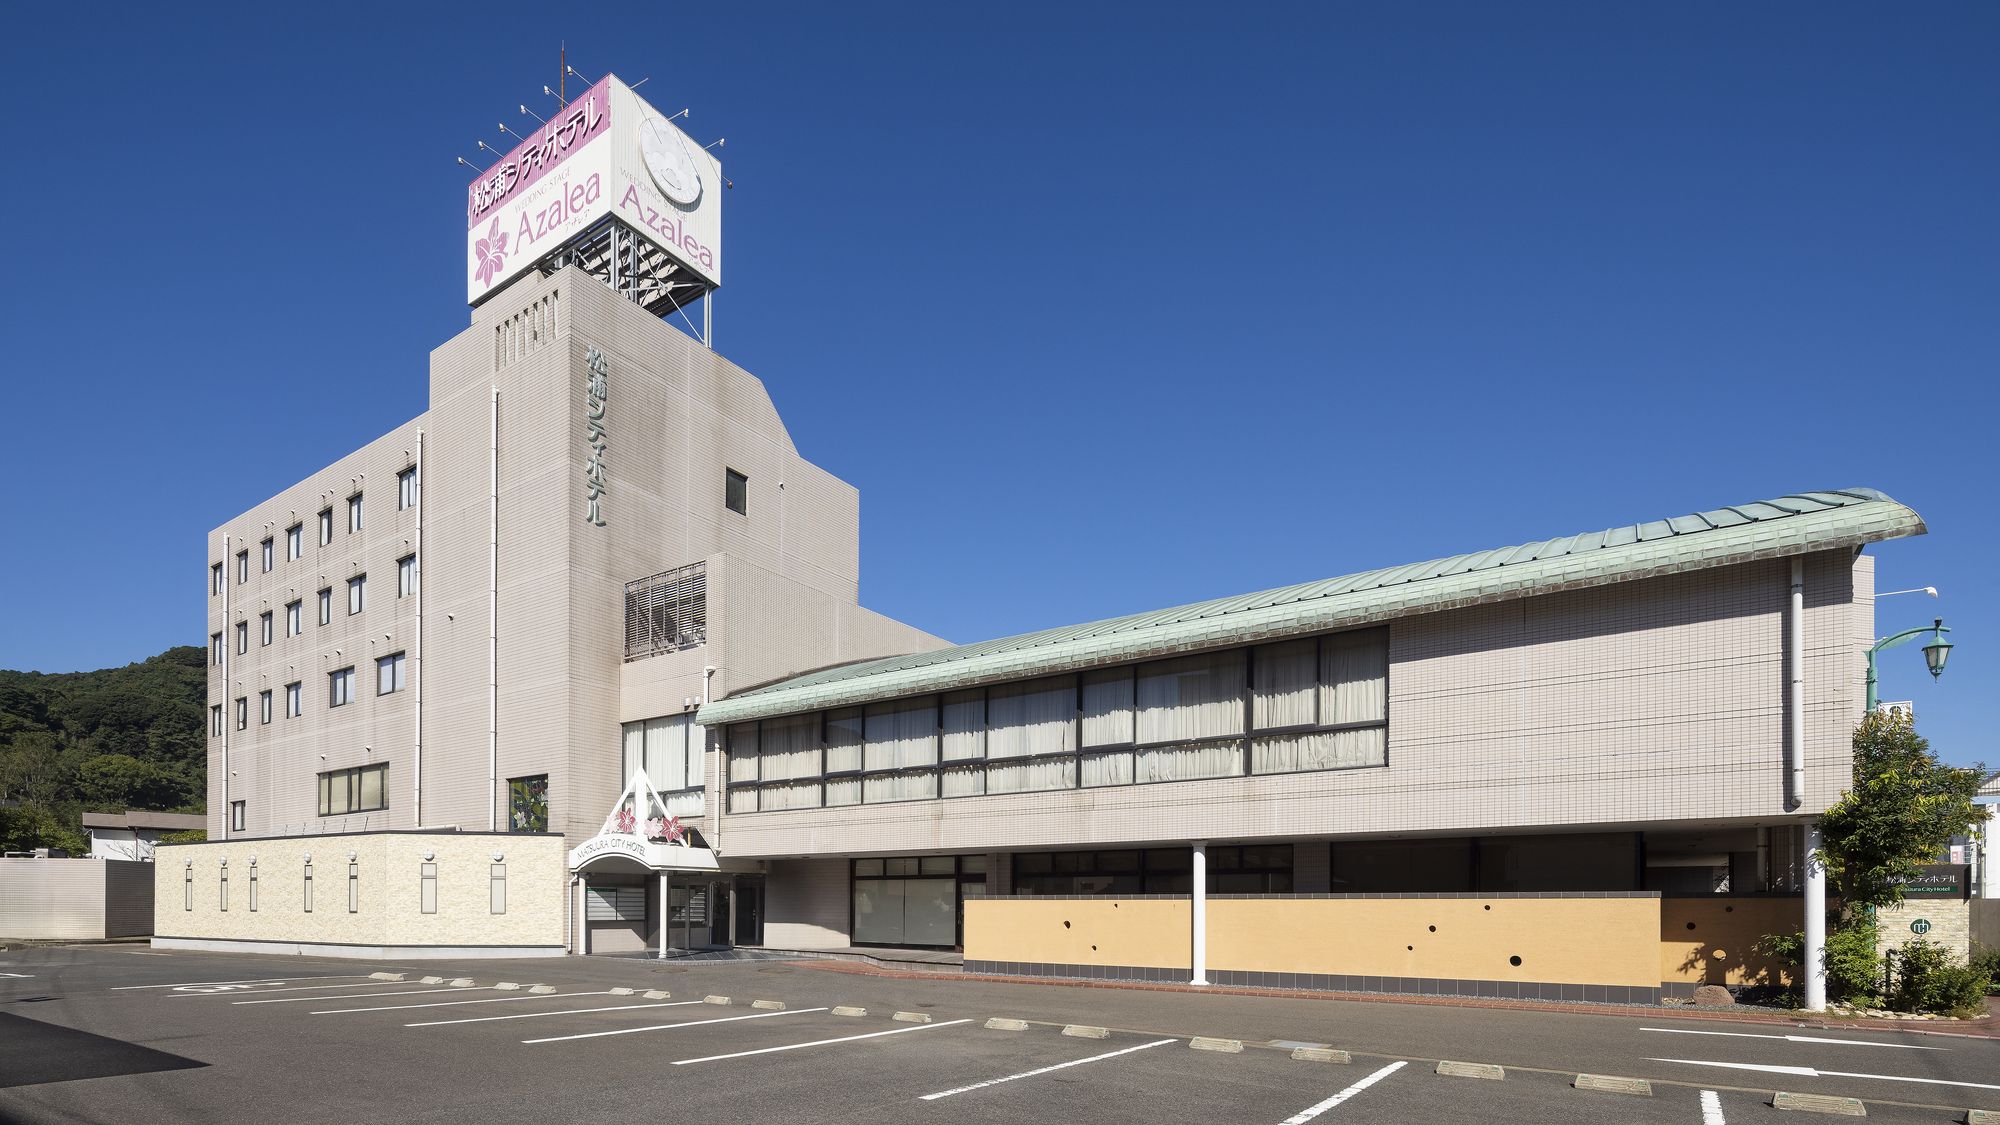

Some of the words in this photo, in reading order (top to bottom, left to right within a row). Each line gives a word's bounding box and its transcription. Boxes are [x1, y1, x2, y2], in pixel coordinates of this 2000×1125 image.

[473, 96, 603, 218] 松浦シティホテル
[549, 167, 571, 188] STAGE
[513, 171, 601, 256] Azalea
[618, 183, 713, 272] Azalea
[586, 344, 608, 527] 松浦シティホテル
[610, 838, 626, 849] CITY
[626, 841, 646, 857] HOTEL
